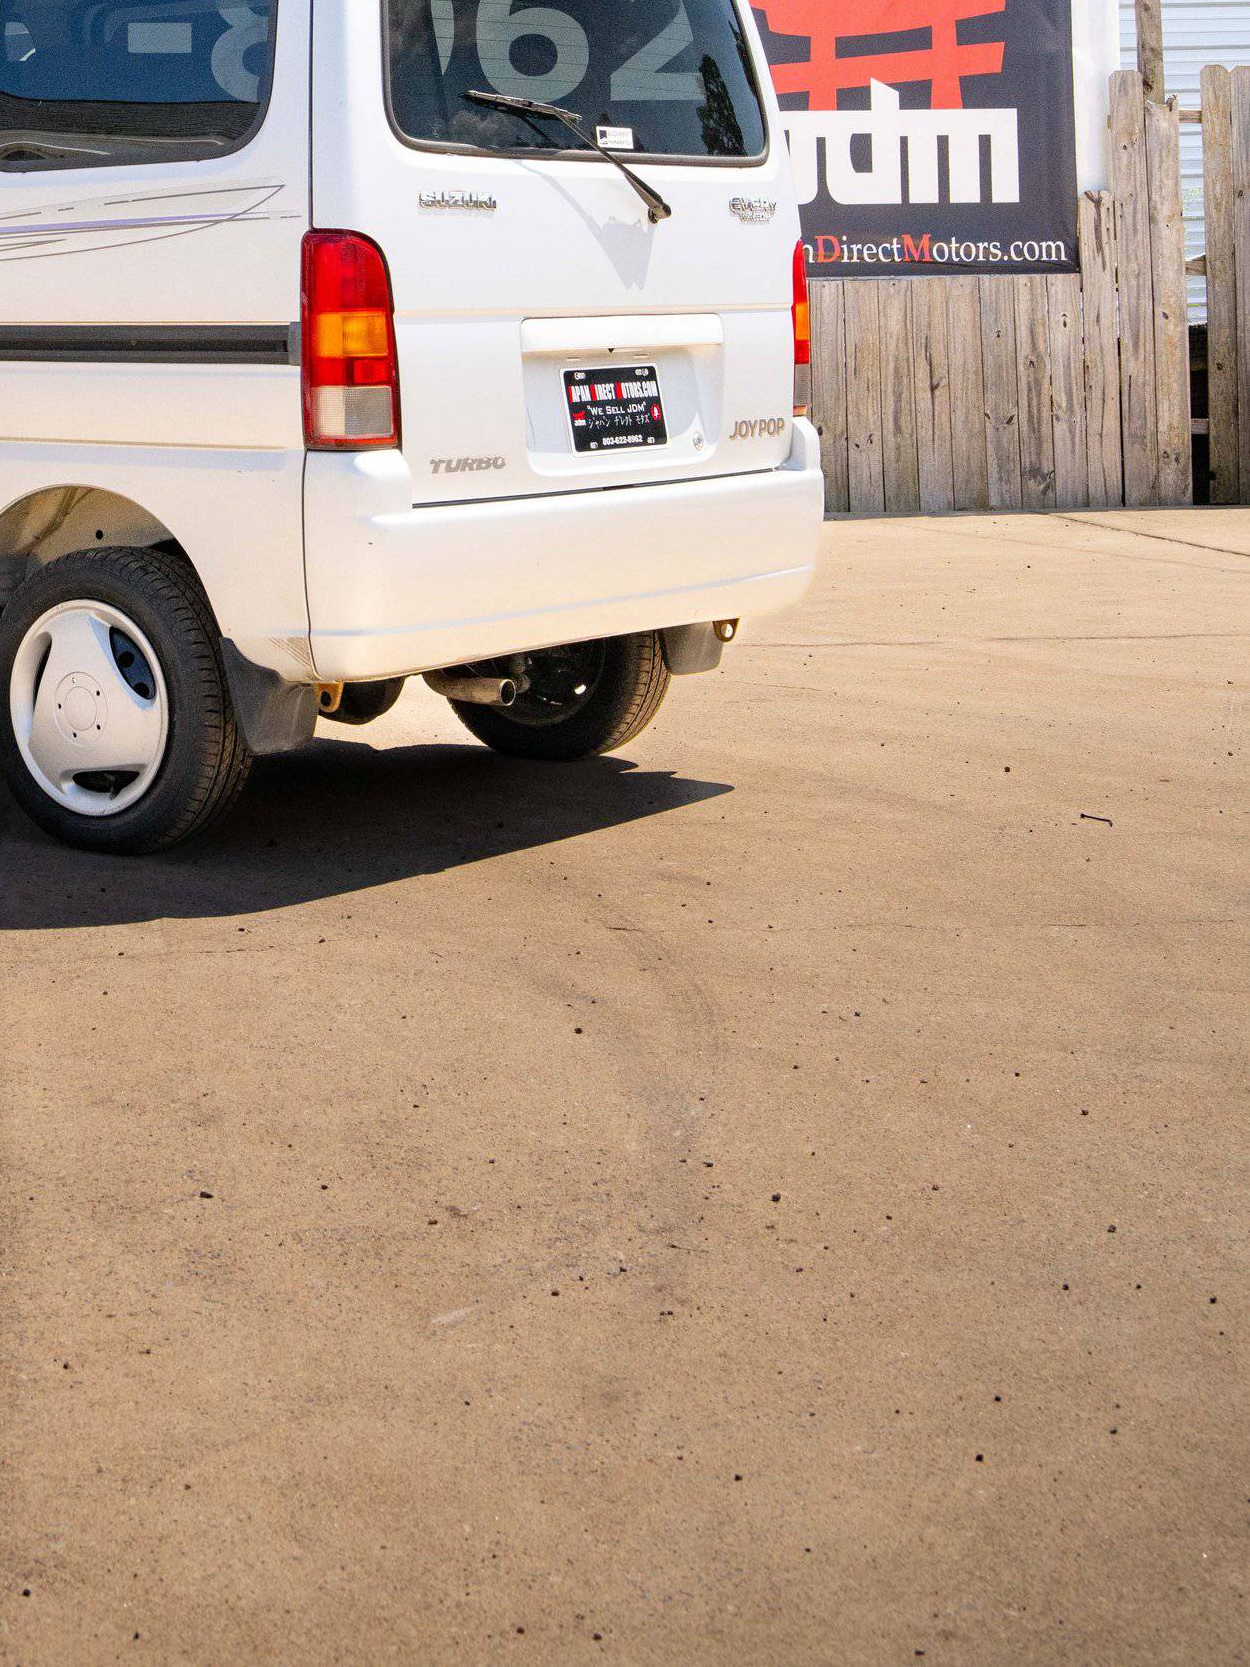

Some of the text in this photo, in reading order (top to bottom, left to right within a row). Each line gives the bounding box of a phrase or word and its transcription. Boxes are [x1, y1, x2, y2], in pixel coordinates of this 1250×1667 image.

[418, 191, 497, 210] SUZUKI
[802, 234, 1068, 264] nDirectMotors.com
[729, 417, 786, 440] JOYPOP
[430, 455, 506, 474] TURBO
